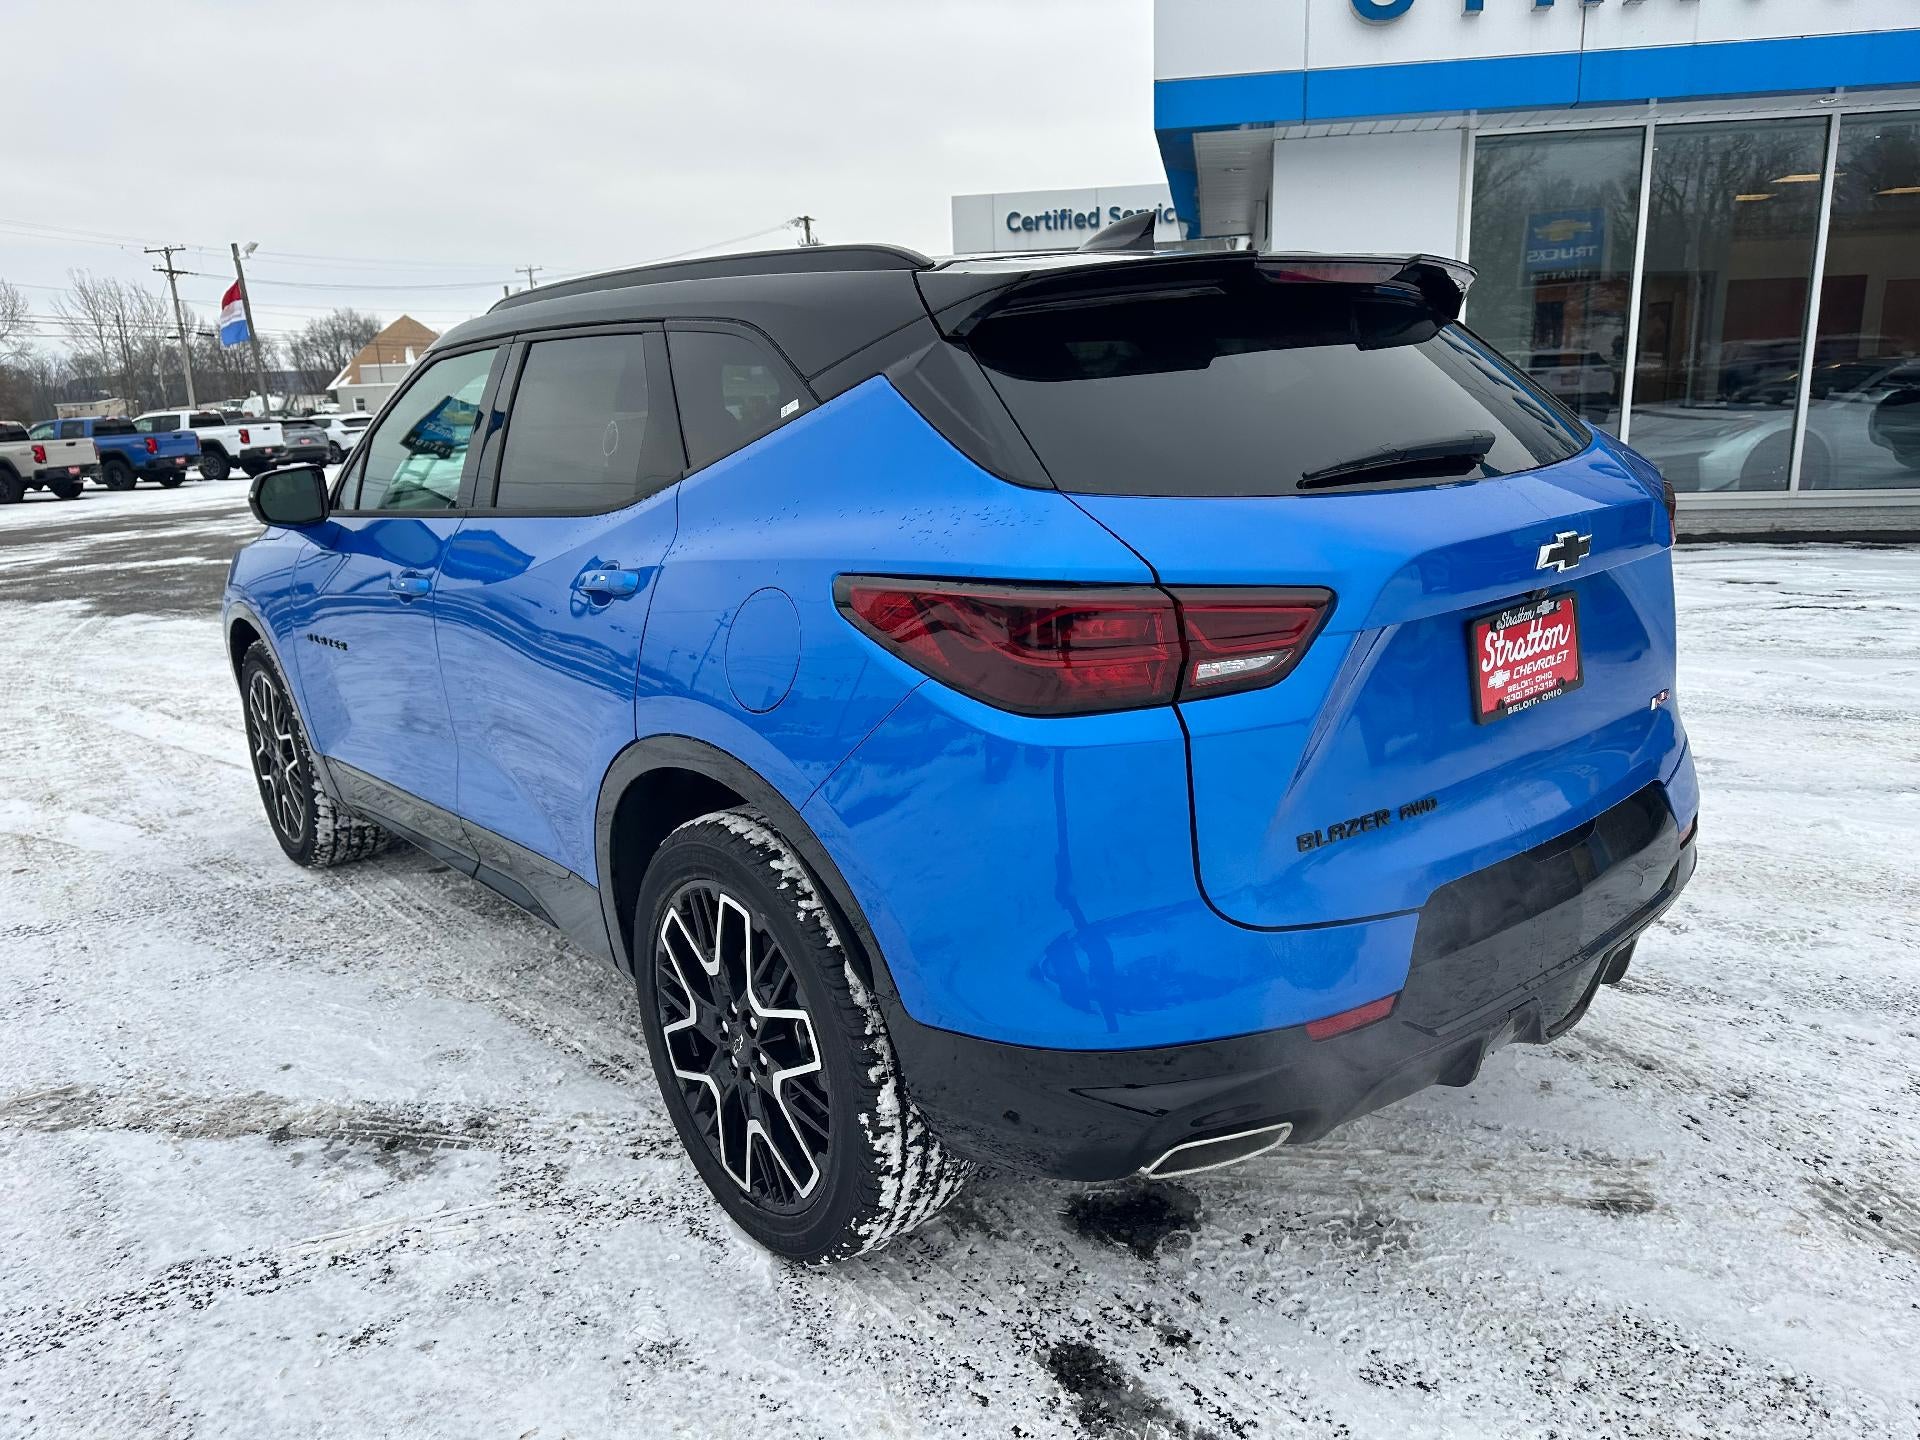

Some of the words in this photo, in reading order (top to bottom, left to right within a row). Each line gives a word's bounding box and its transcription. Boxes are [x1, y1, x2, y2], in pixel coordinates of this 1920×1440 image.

[1006, 206, 1101, 233] Certified
[1500, 606, 1536, 629] Stratton
[1481, 616, 1571, 672] Stratton
[1513, 649, 1569, 679] CHEVROLET
[1535, 670, 1553, 683] OHIO
[1541, 688, 1562, 702] OHIO
[1296, 808, 1391, 852] BLAZER
[1399, 796, 1438, 820] AWD
